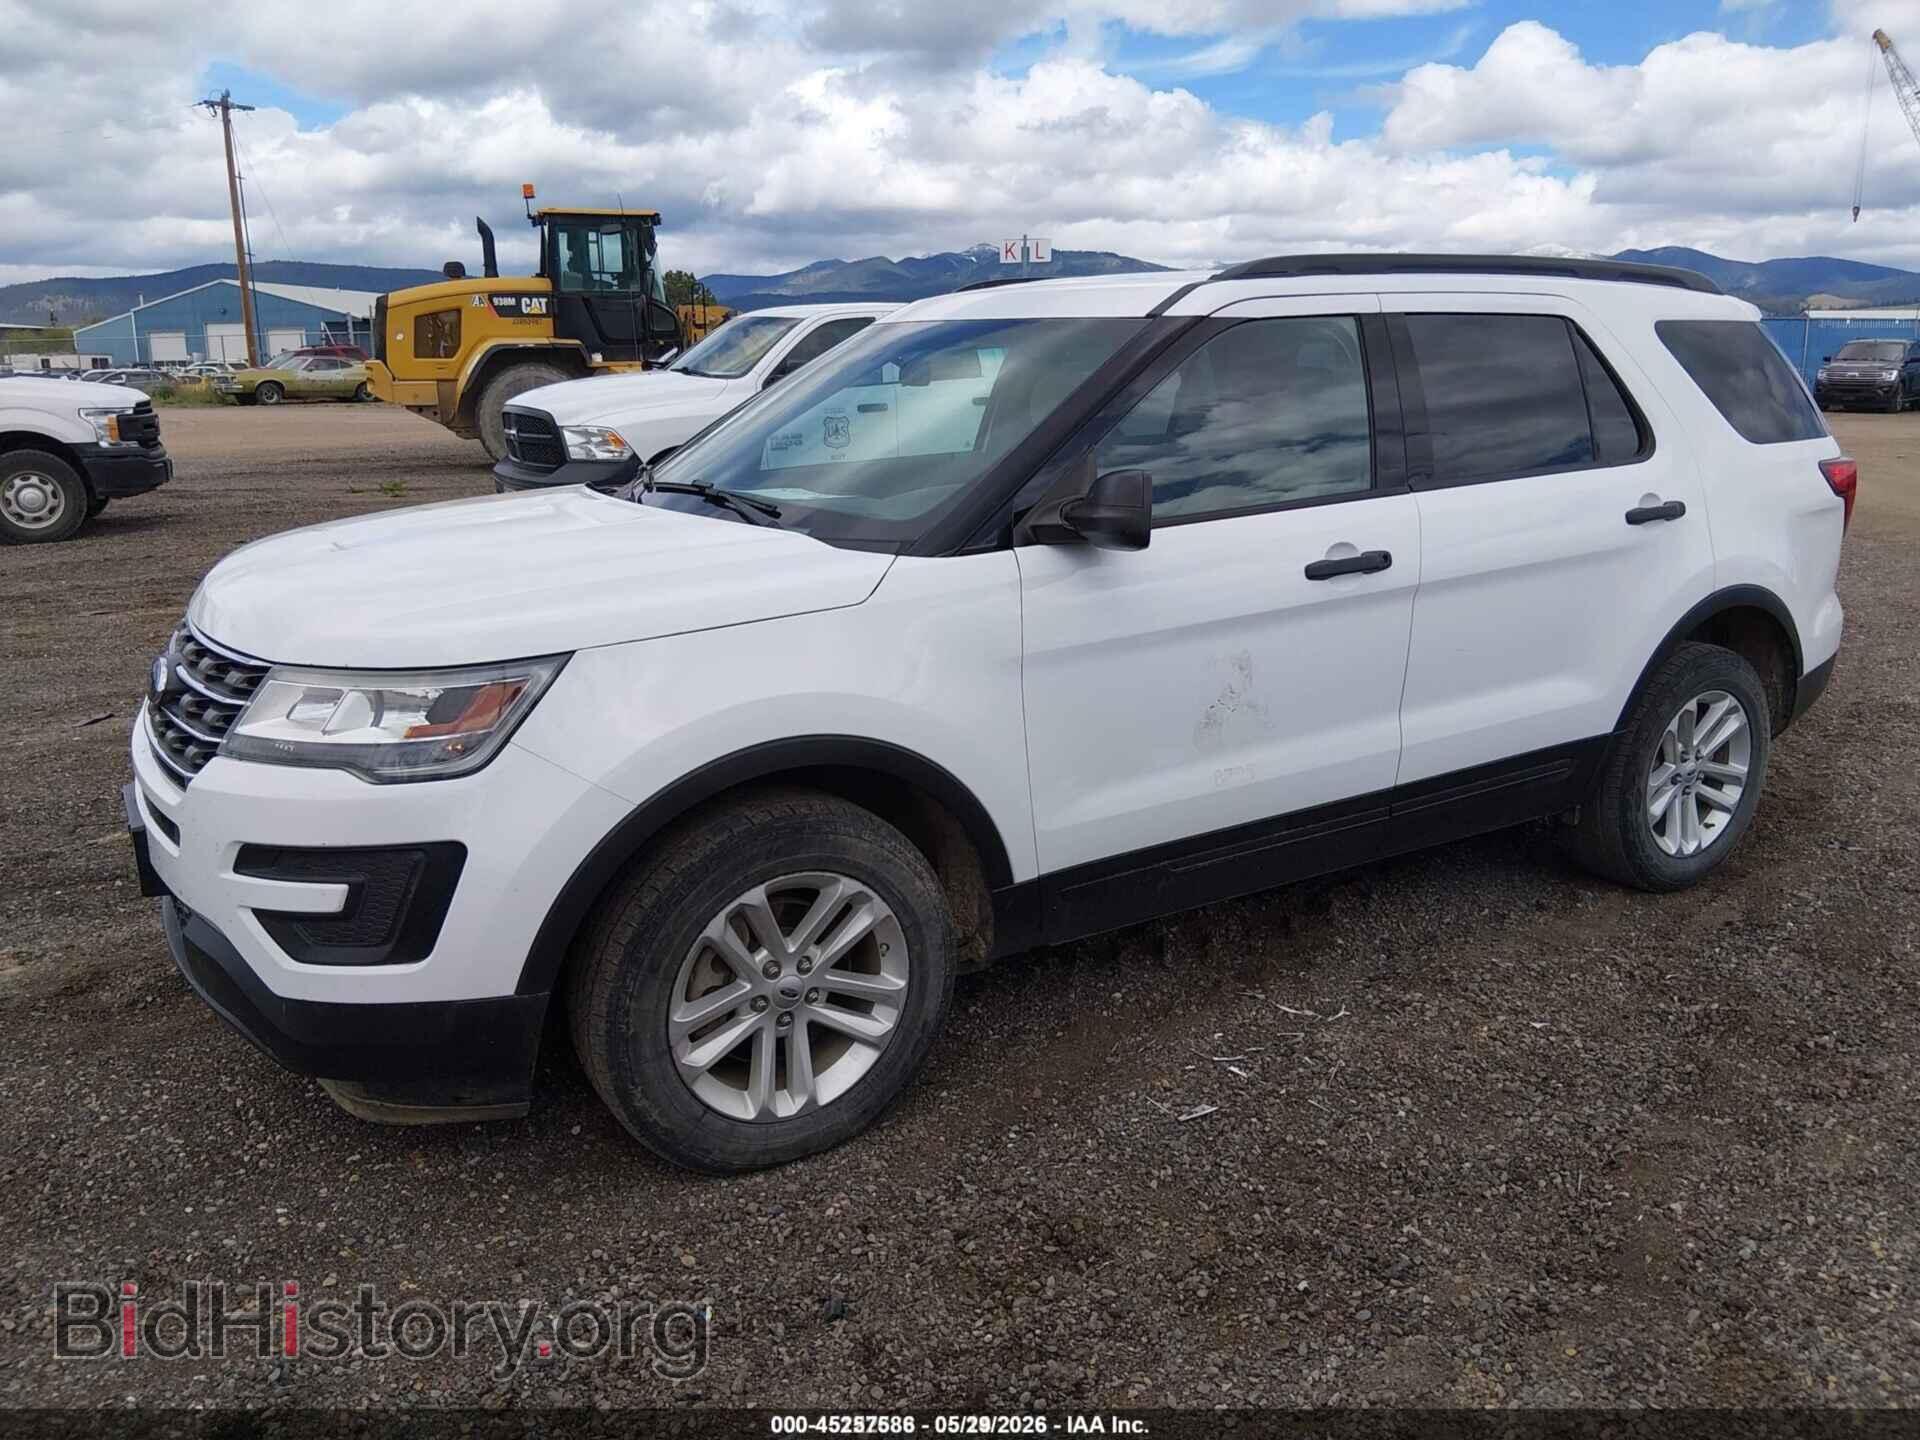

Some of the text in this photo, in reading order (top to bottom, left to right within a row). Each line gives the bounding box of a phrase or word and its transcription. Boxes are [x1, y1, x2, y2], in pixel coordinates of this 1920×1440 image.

[1005, 241, 1017, 261] K
[1035, 241, 1046, 260] L
[521, 297, 548, 314] CAT
